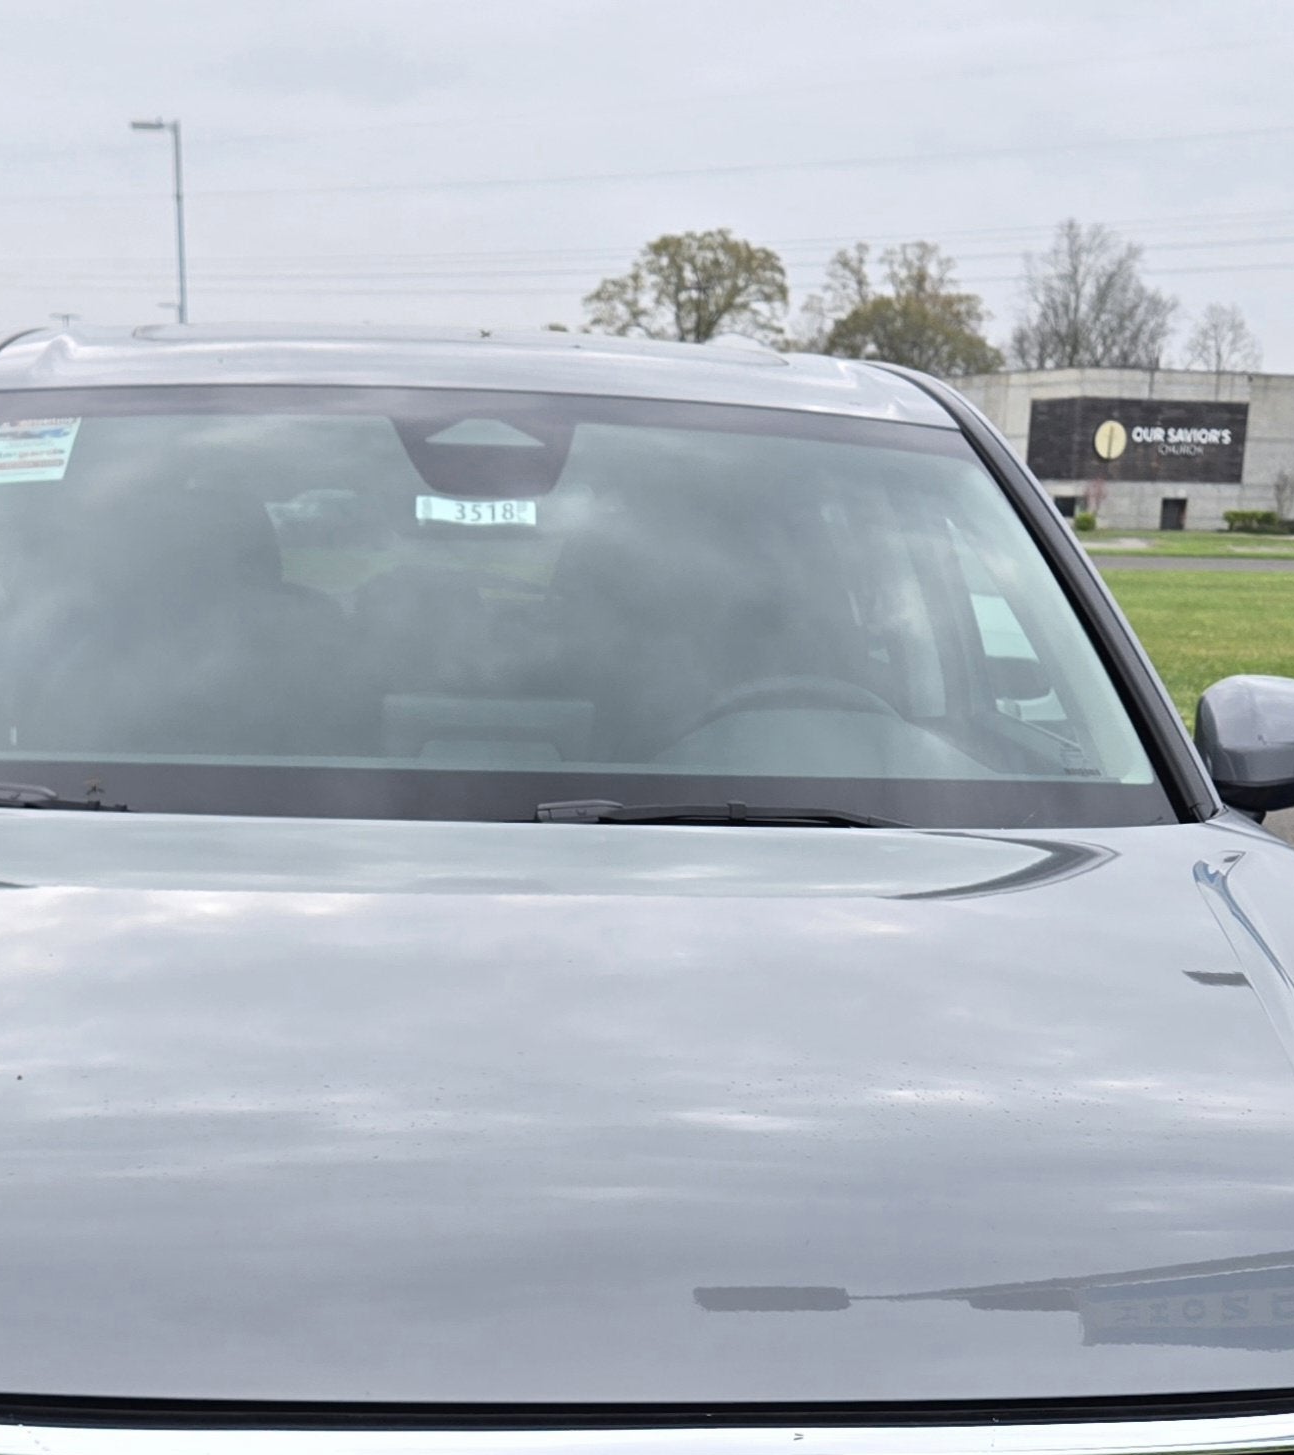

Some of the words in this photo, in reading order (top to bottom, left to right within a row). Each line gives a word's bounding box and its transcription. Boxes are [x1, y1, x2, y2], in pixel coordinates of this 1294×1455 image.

[1132, 426, 1165, 443] OUR
[1167, 427, 1232, 445] SAVIOR'S
[455, 502, 514, 521] 3518
